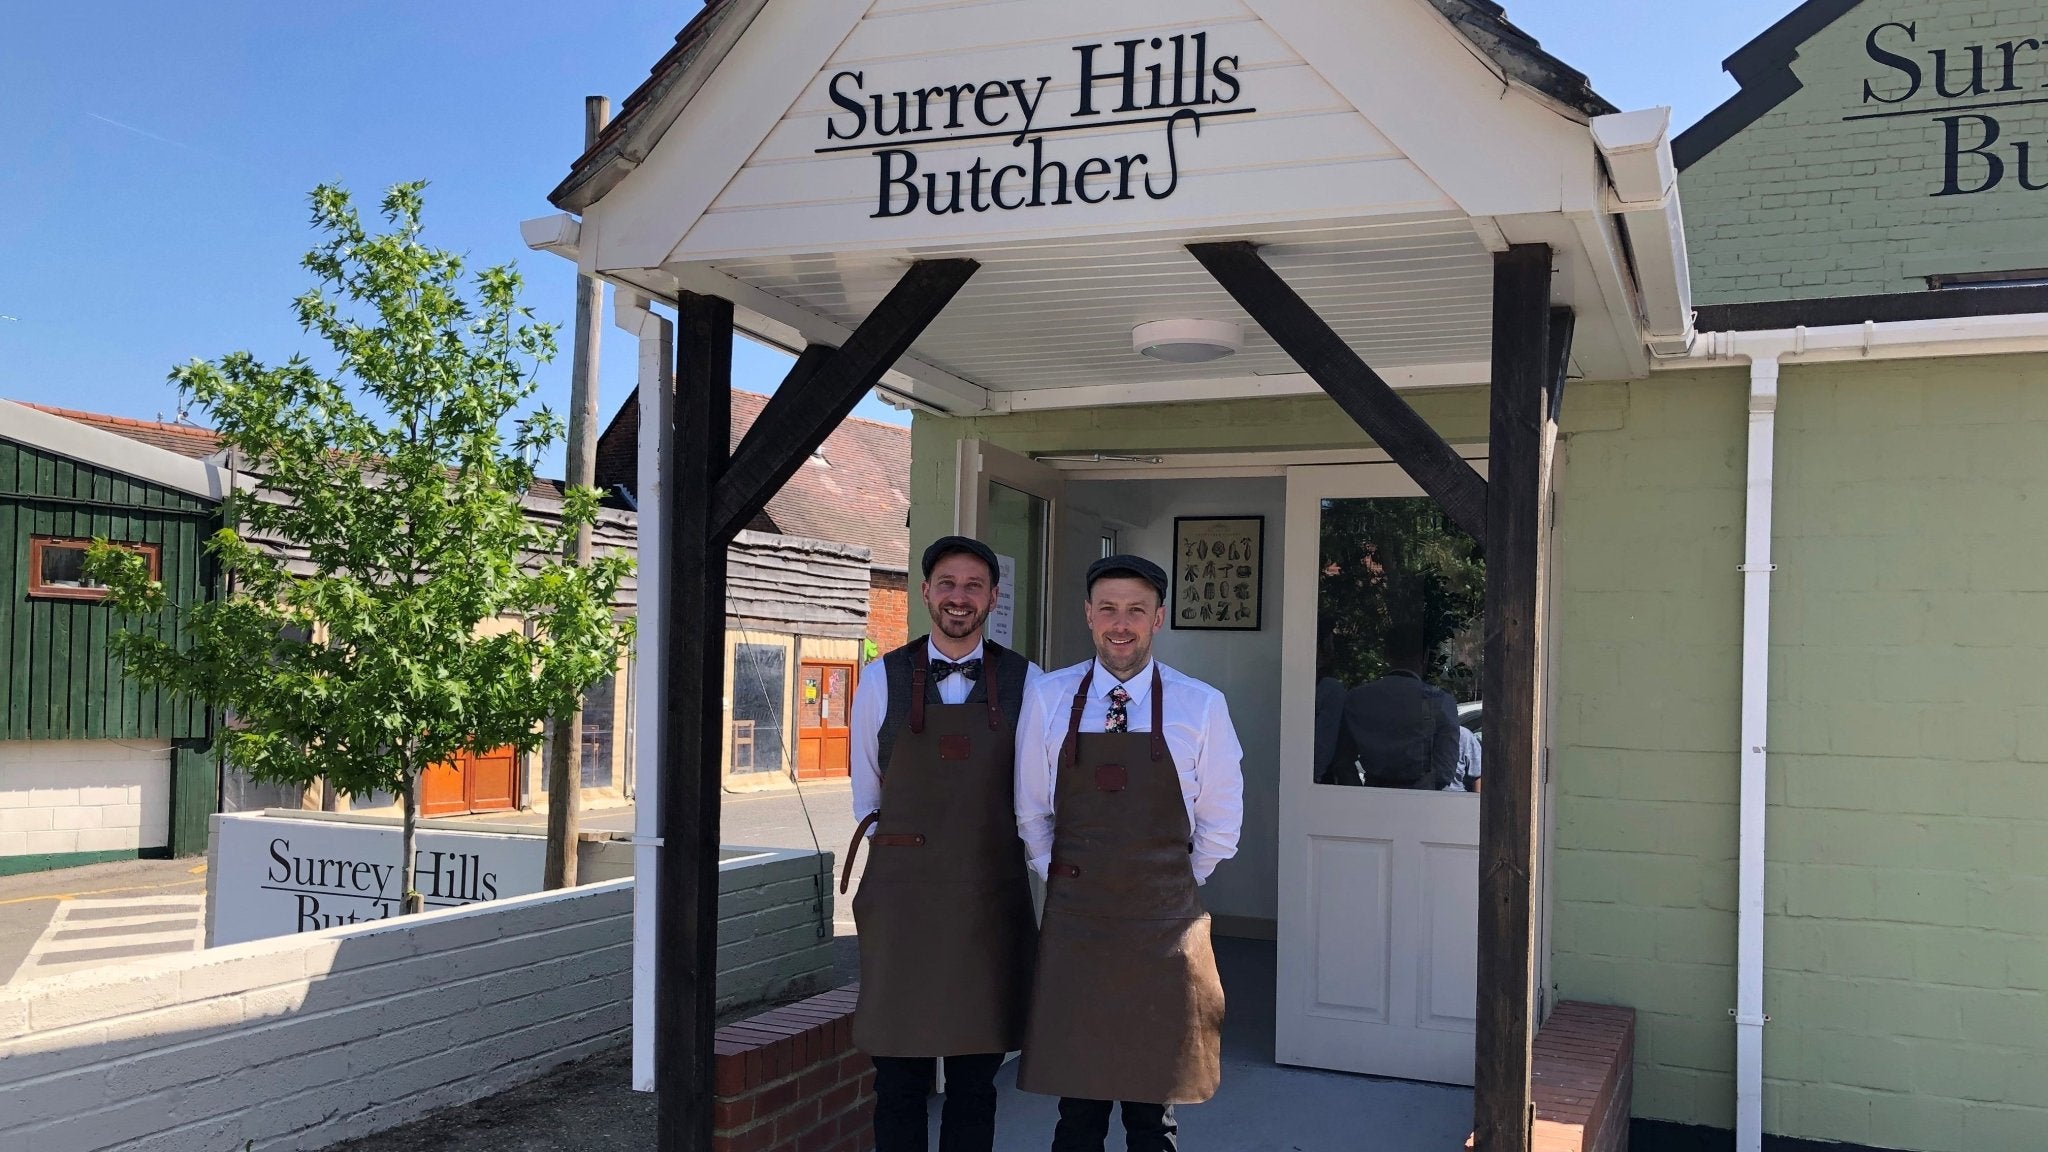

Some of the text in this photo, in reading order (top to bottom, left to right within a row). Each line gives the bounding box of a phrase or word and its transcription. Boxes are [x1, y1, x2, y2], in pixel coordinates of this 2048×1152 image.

[828, 31, 1241, 147] Surrey Hills
[1863, 21, 2048, 103] Sur
[869, 108, 1201, 218] Butchers
[268, 838, 498, 907] Surrey Hills
